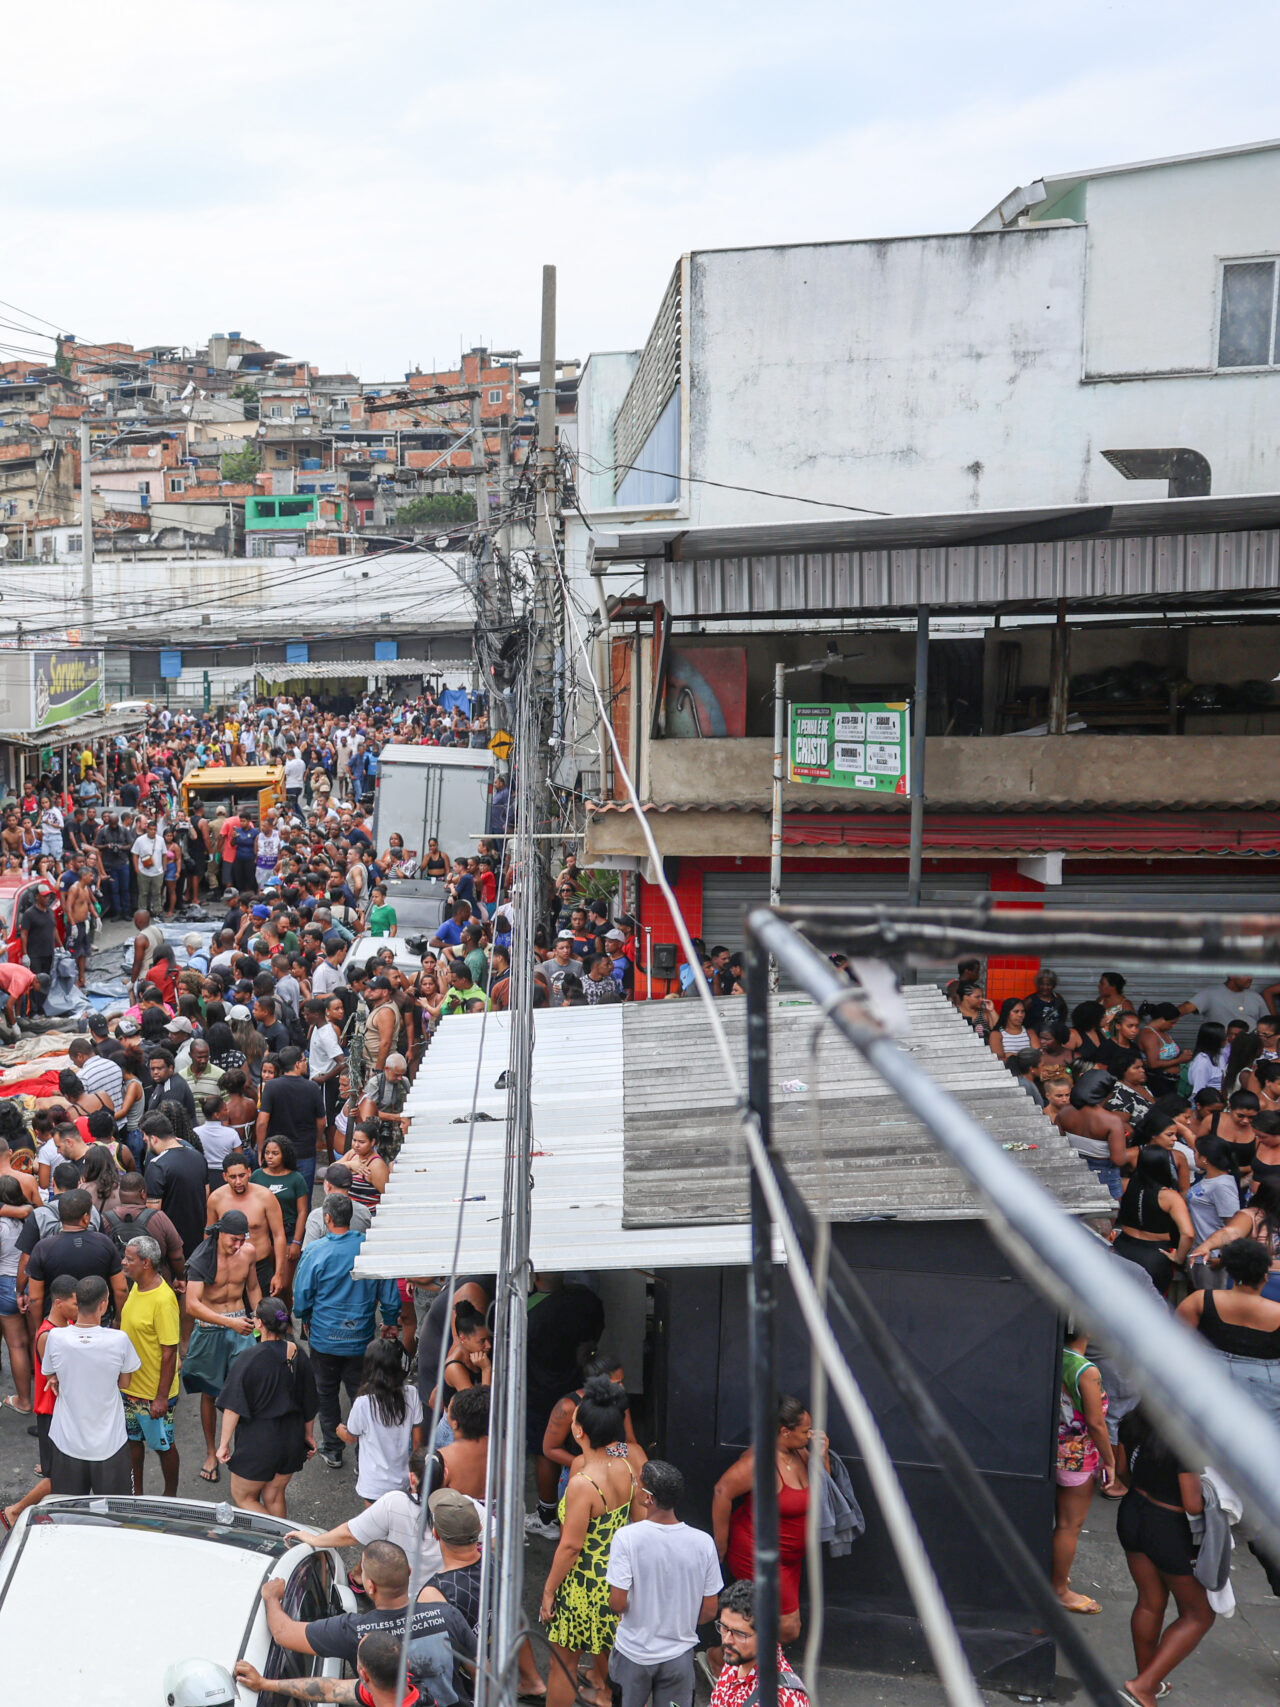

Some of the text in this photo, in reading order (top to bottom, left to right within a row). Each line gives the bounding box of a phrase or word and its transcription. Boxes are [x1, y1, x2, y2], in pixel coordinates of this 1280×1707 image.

[50, 654, 86, 695] Sorvetes
[796, 737, 828, 766] CRISTO
[356, 1620, 395, 1632] SPOTLESS
